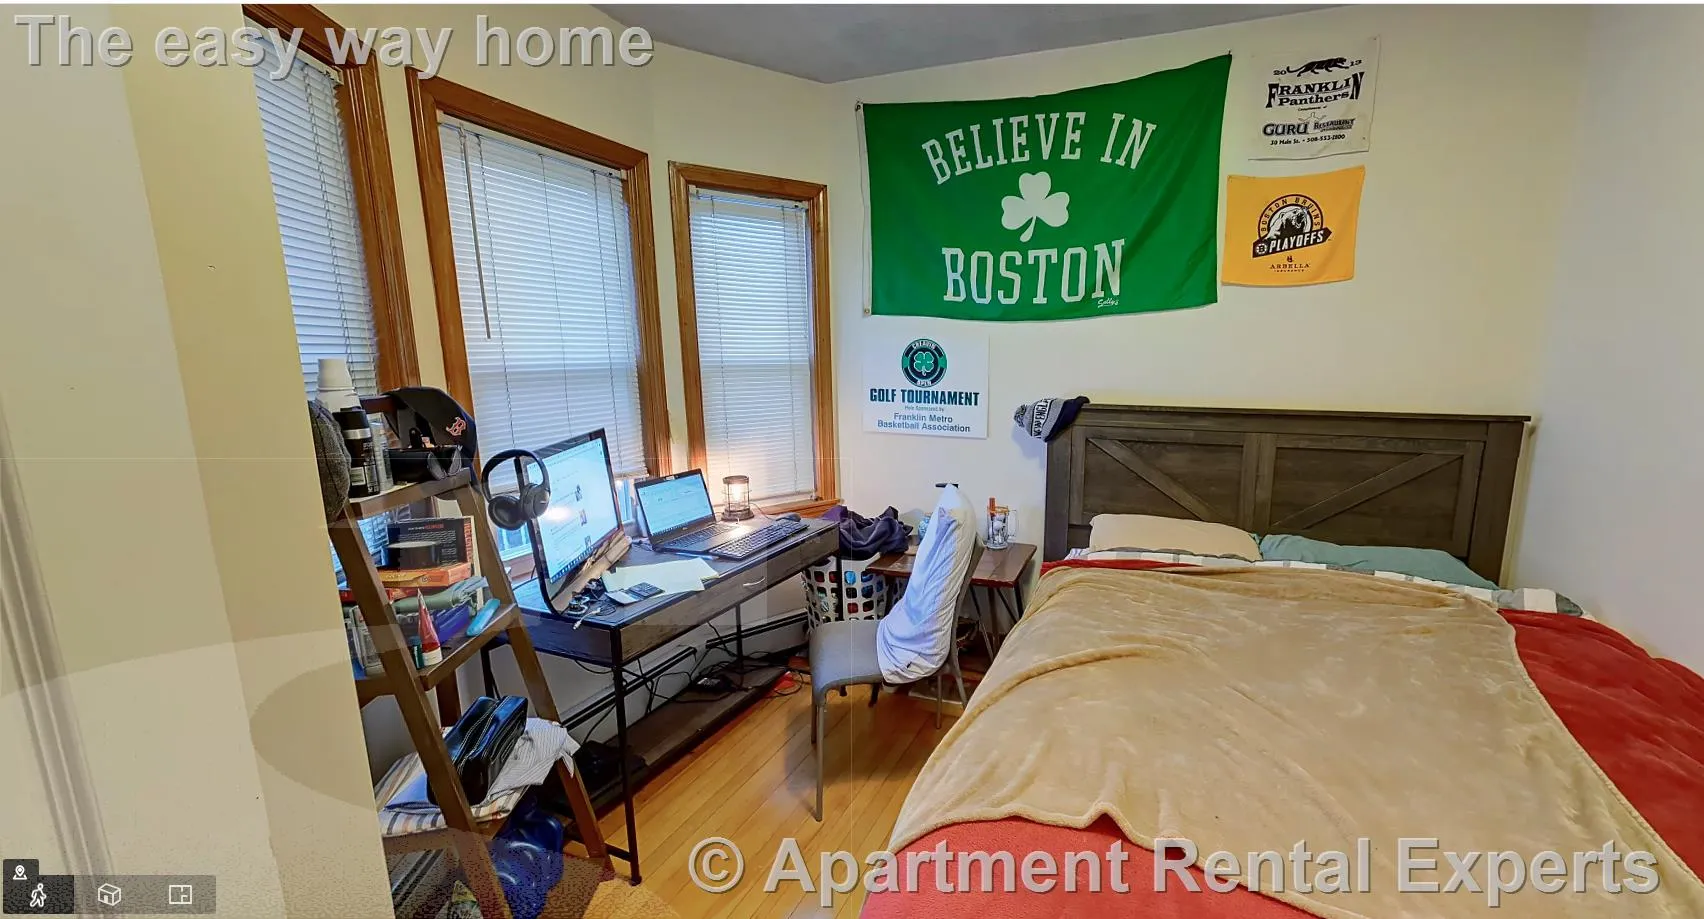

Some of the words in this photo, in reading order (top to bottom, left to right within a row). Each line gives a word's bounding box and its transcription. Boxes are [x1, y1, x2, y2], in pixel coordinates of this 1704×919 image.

[1278, 92, 1350, 106] Panthers
[1263, 122, 1308, 136] GURU
[922, 111, 1086, 185] BELIEVE
[1100, 112, 1157, 170] IN
[1261, 198, 1288, 232] BOSTON
[1295, 197, 1321, 227] BRUINS
[1269, 230, 1324, 253] PLAYOFFS
[942, 238, 1125, 304] BOSTON
[870, 388, 896, 402] GOLF
[901, 389, 979, 406] TOURNAMENT
[877, 420, 919, 429] Basketball
[922, 423, 971, 432] Association
[894, 412, 926, 421] Franklin
[929, 414, 953, 423] Metro
